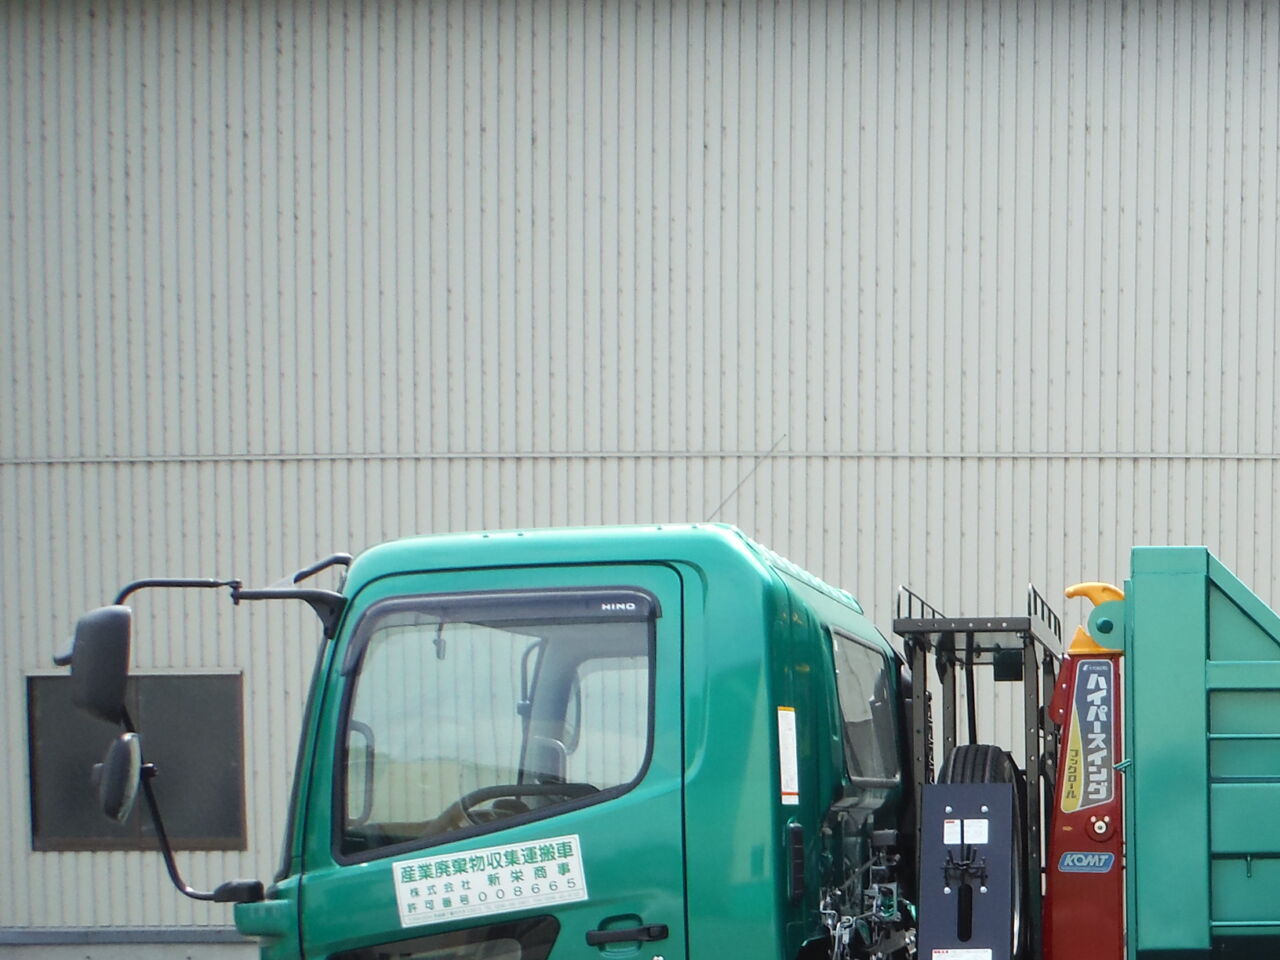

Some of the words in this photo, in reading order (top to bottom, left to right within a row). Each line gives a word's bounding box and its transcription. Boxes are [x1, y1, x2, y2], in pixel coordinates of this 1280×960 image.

[601, 602, 636, 611] HINO
[1086, 673, 1109, 799] ハイパースイング
[400, 840, 574, 884] 産業廃棄物収集運搬車
